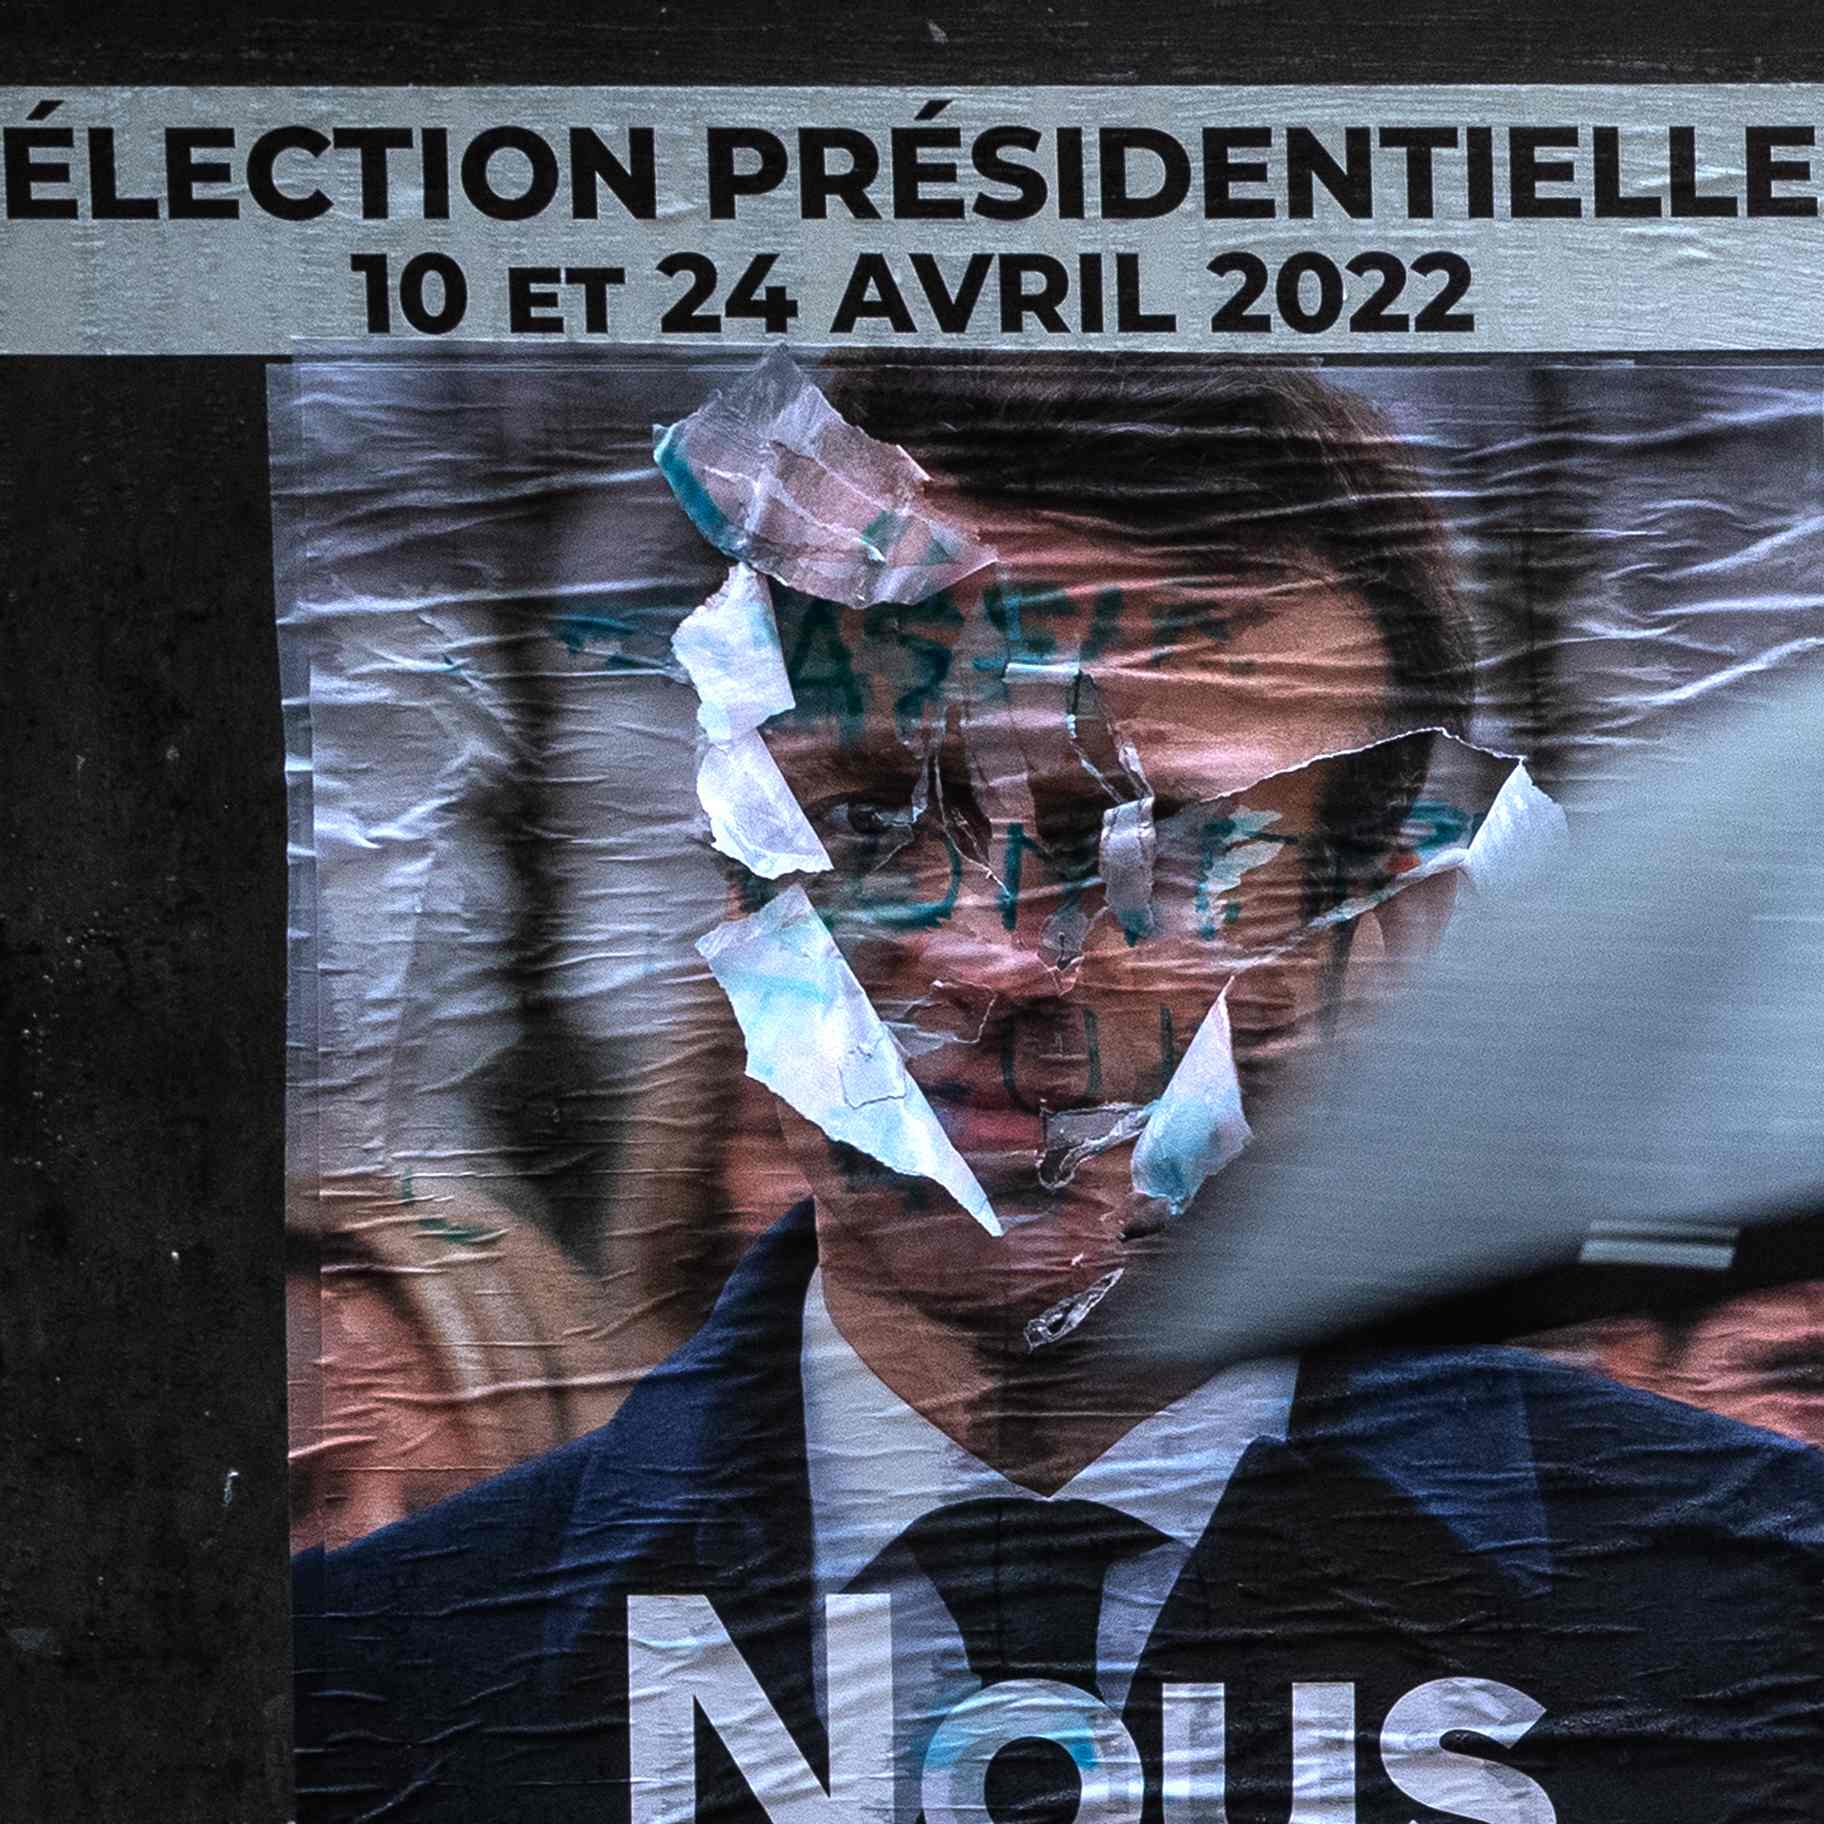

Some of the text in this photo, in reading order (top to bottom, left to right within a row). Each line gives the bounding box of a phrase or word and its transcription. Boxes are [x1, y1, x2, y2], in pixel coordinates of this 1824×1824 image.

[4, 98, 1819, 221] ÉLECTION PRÉSIDENTIELLE
[351, 250, 1475, 336] 10 ET 24 AVRIL 2022
